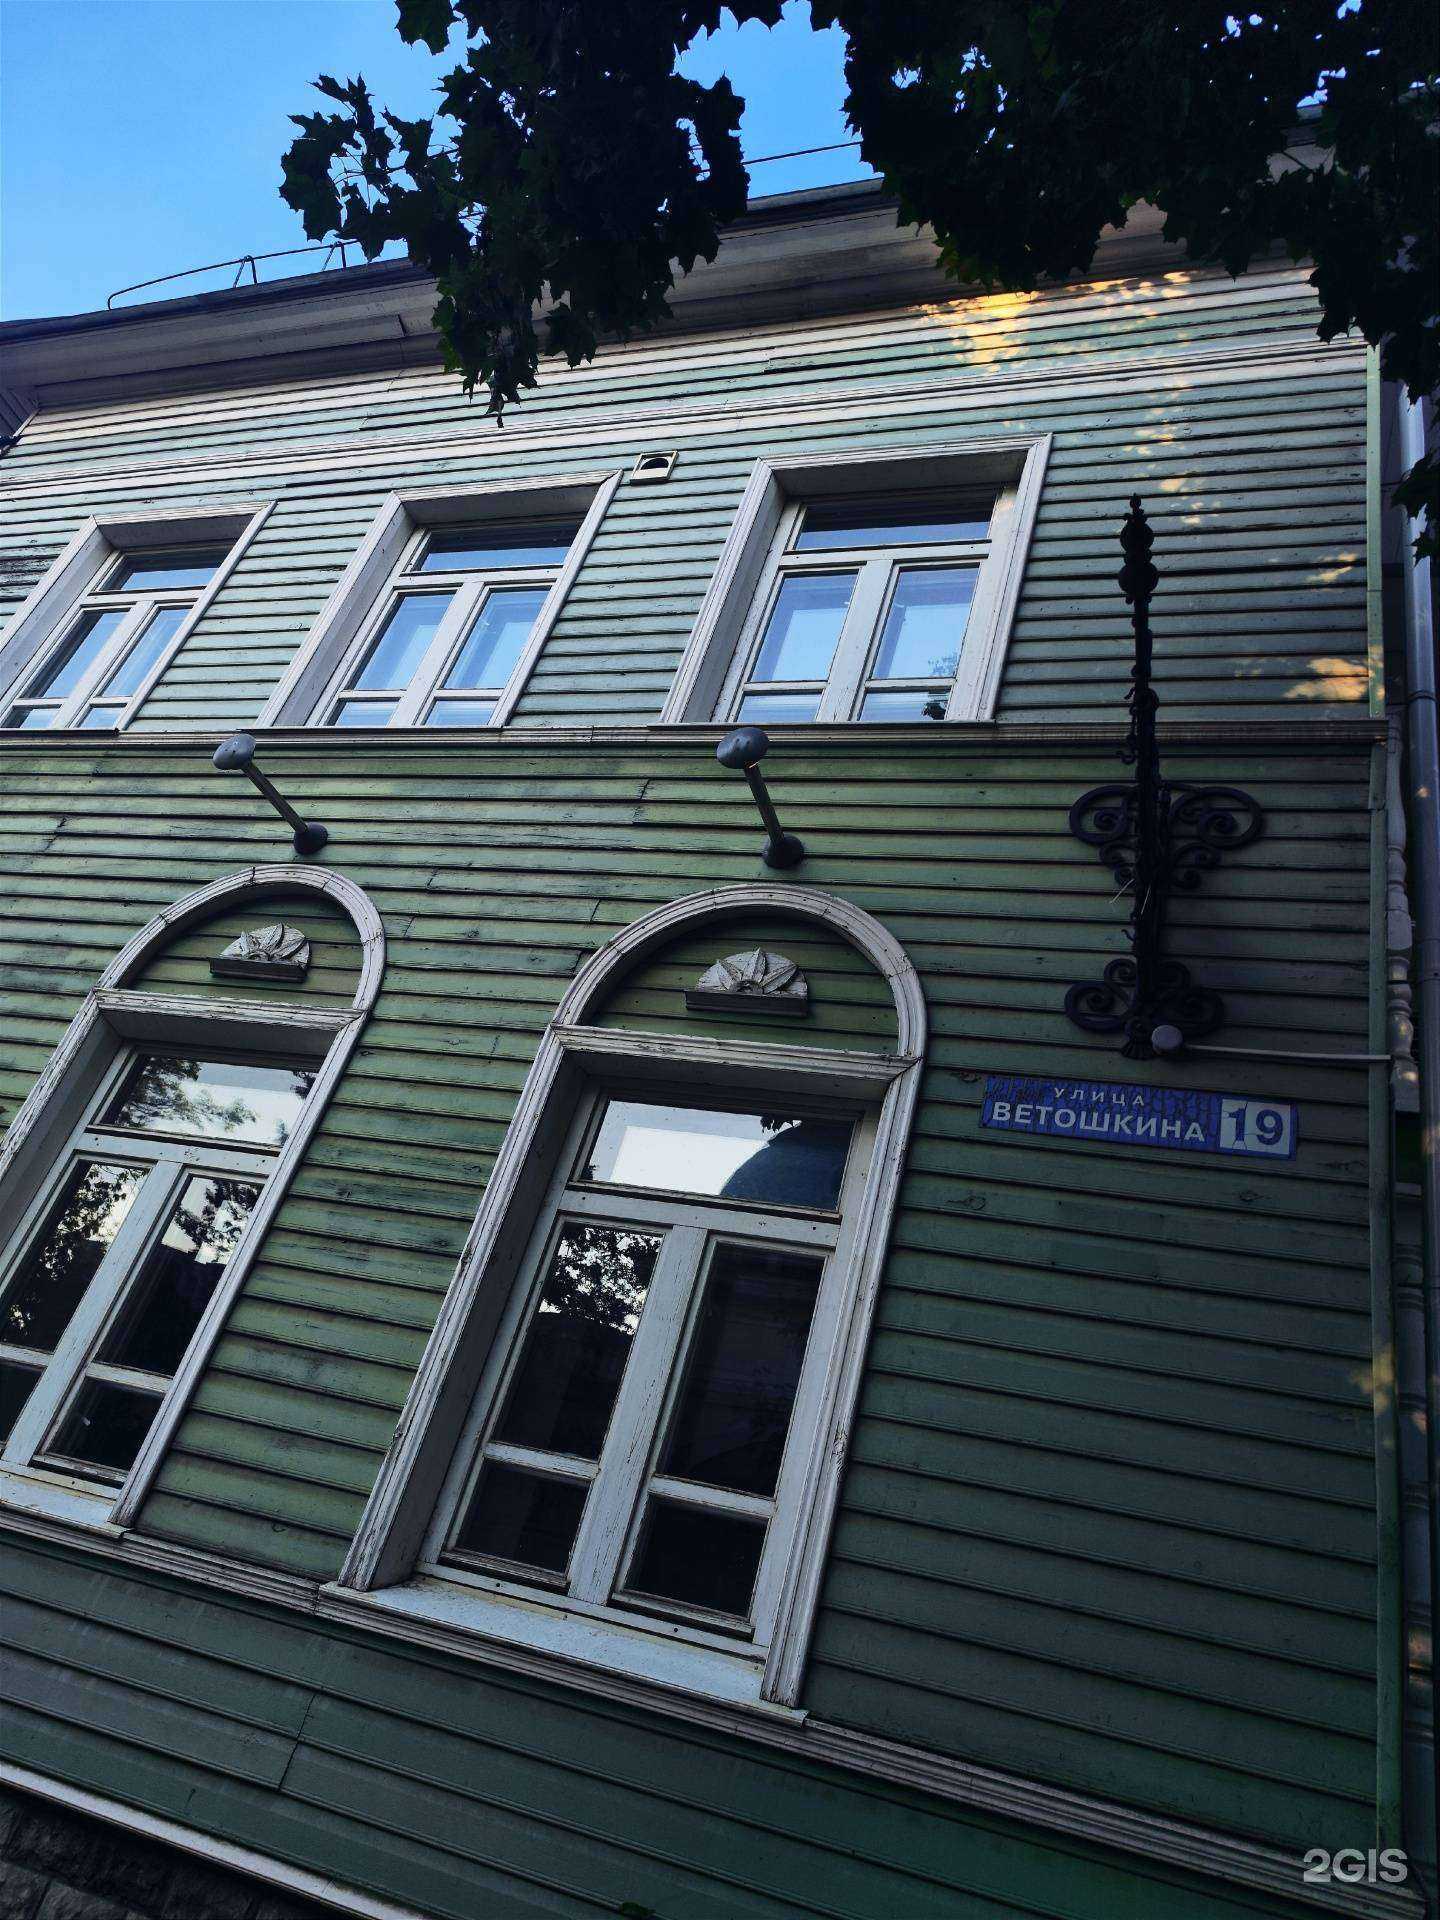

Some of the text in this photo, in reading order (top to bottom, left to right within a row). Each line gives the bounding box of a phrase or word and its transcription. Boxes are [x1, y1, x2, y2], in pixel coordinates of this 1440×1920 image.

[1054, 1087, 1145, 1106] УЛИЦА
[992, 1101, 1205, 1142] ВЕТОШКИНА
[1225, 1107, 1283, 1146] 19
